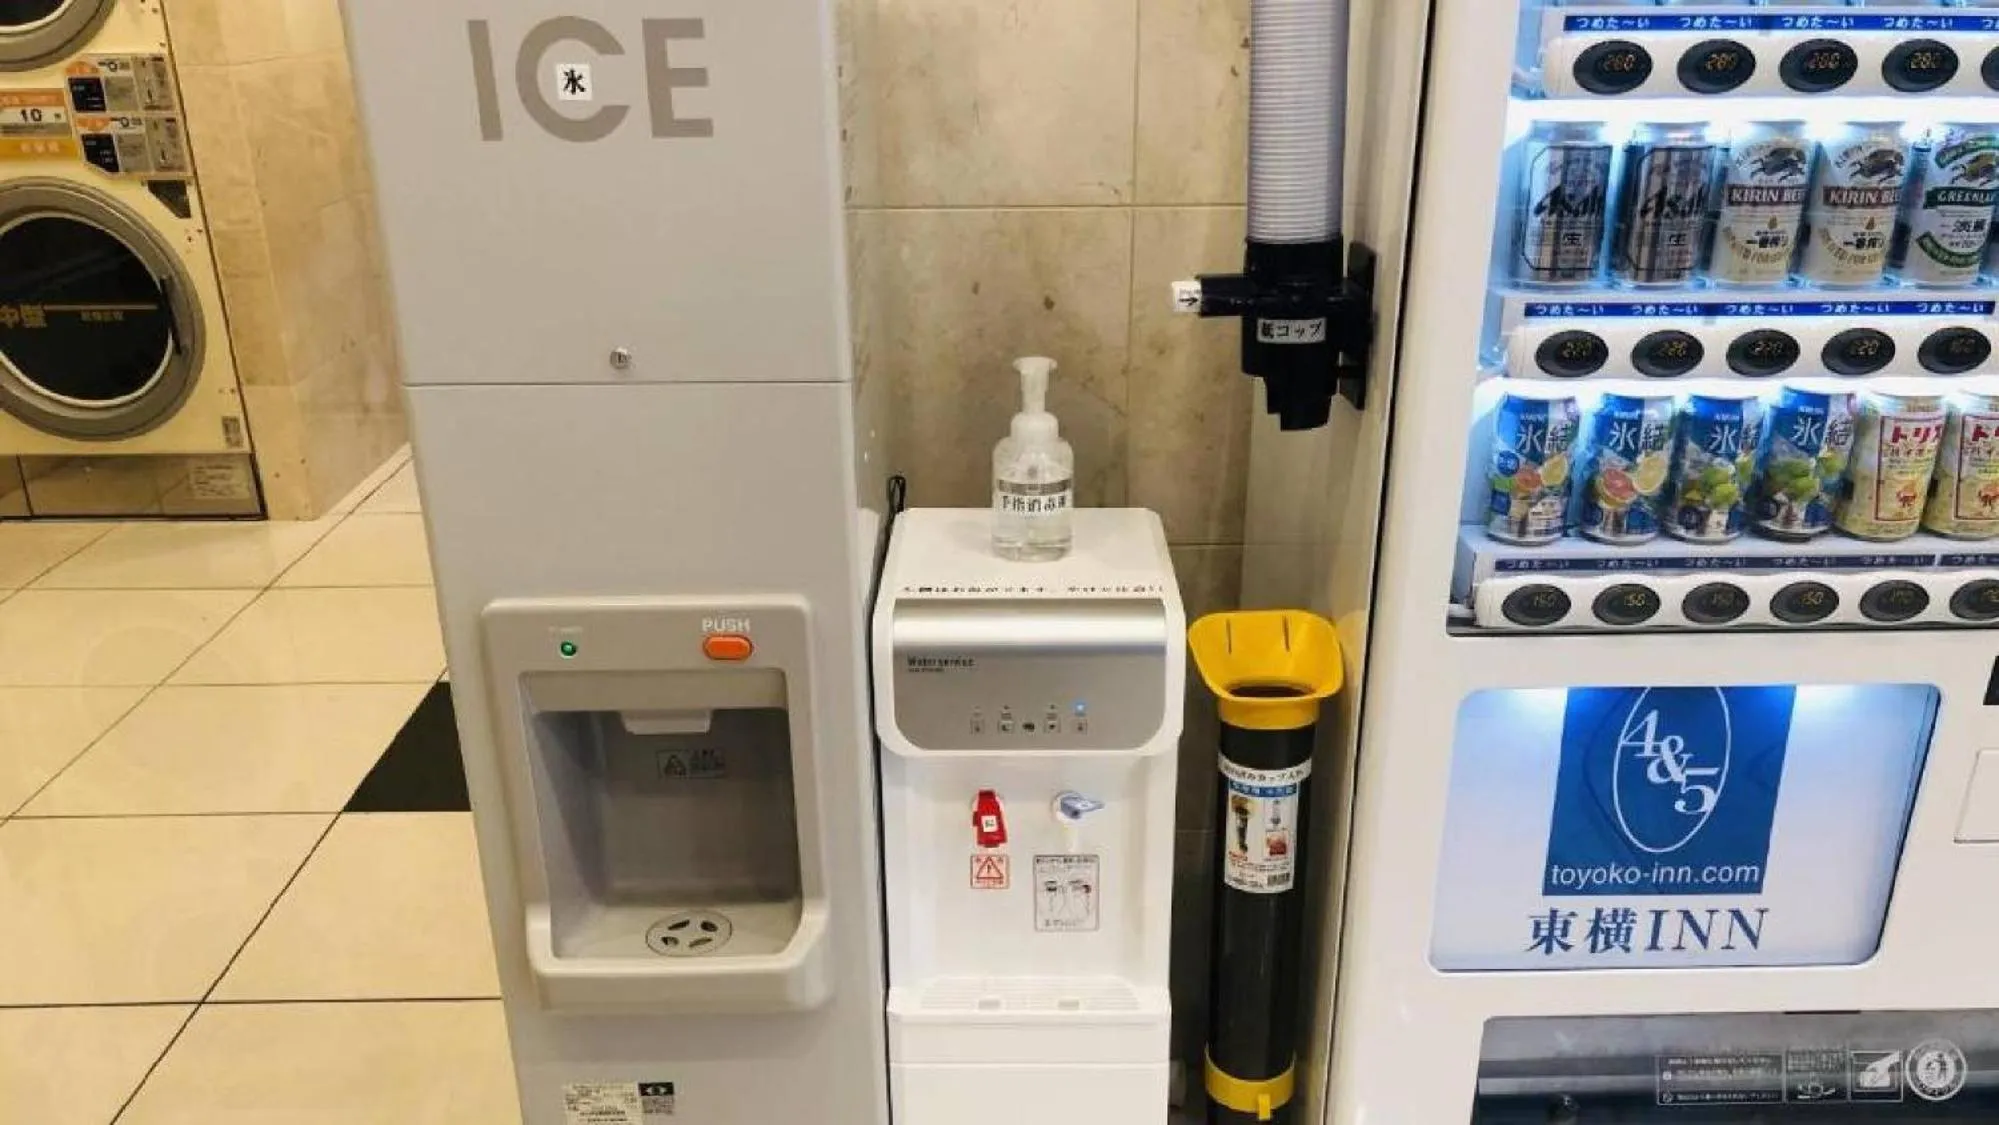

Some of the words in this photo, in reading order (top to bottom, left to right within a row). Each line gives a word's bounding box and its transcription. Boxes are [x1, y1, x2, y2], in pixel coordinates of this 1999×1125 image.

[467, 15, 713, 142] ICE
[20, 108, 43, 122] 10
[1731, 187, 1779, 202] KIRIN
[1830, 189, 1877, 204] KIRIN
[702, 618, 750, 632] PUSH
[1551, 862, 1760, 891] toyoko-inn.com
[1524, 907, 1770, 955] 東横INN
